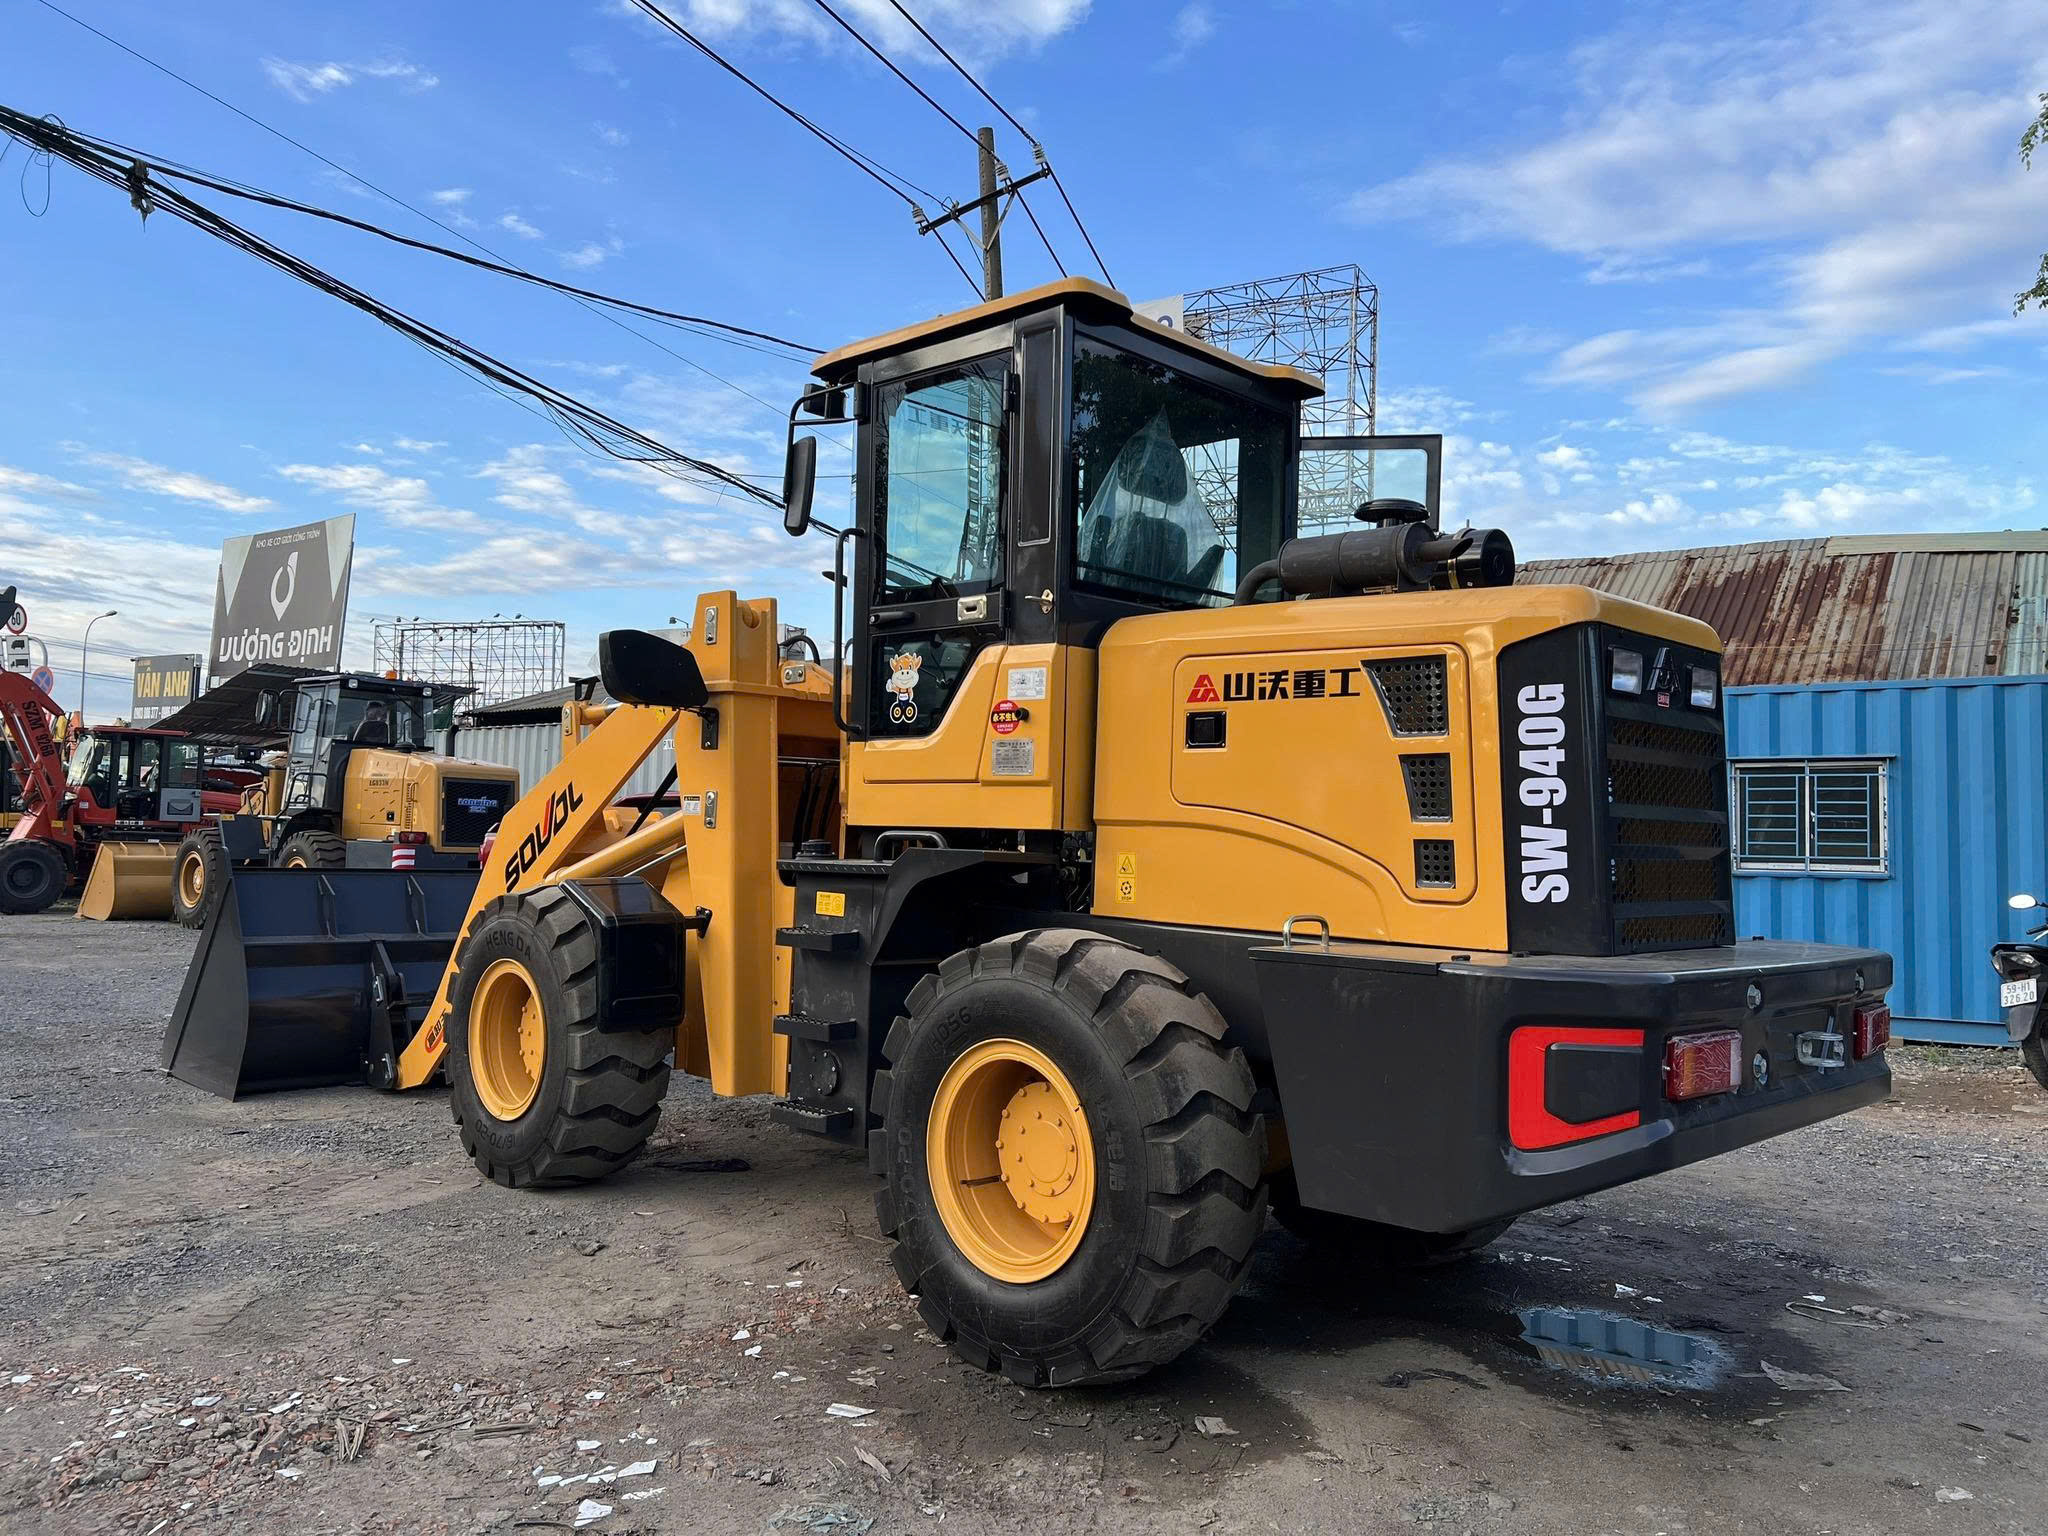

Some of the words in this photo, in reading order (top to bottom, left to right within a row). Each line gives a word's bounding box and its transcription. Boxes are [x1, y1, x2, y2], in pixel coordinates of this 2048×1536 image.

[288, 625, 333, 663] ĐỊNH
[137, 667, 161, 698] VÂN
[163, 671, 190, 697] ANH
[1223, 667, 1361, 702] 山沃重工
[23, 701, 45, 731] SZM
[1517, 683, 1570, 904] SW-940G
[2007, 982, 2030, 994] 59-H1
